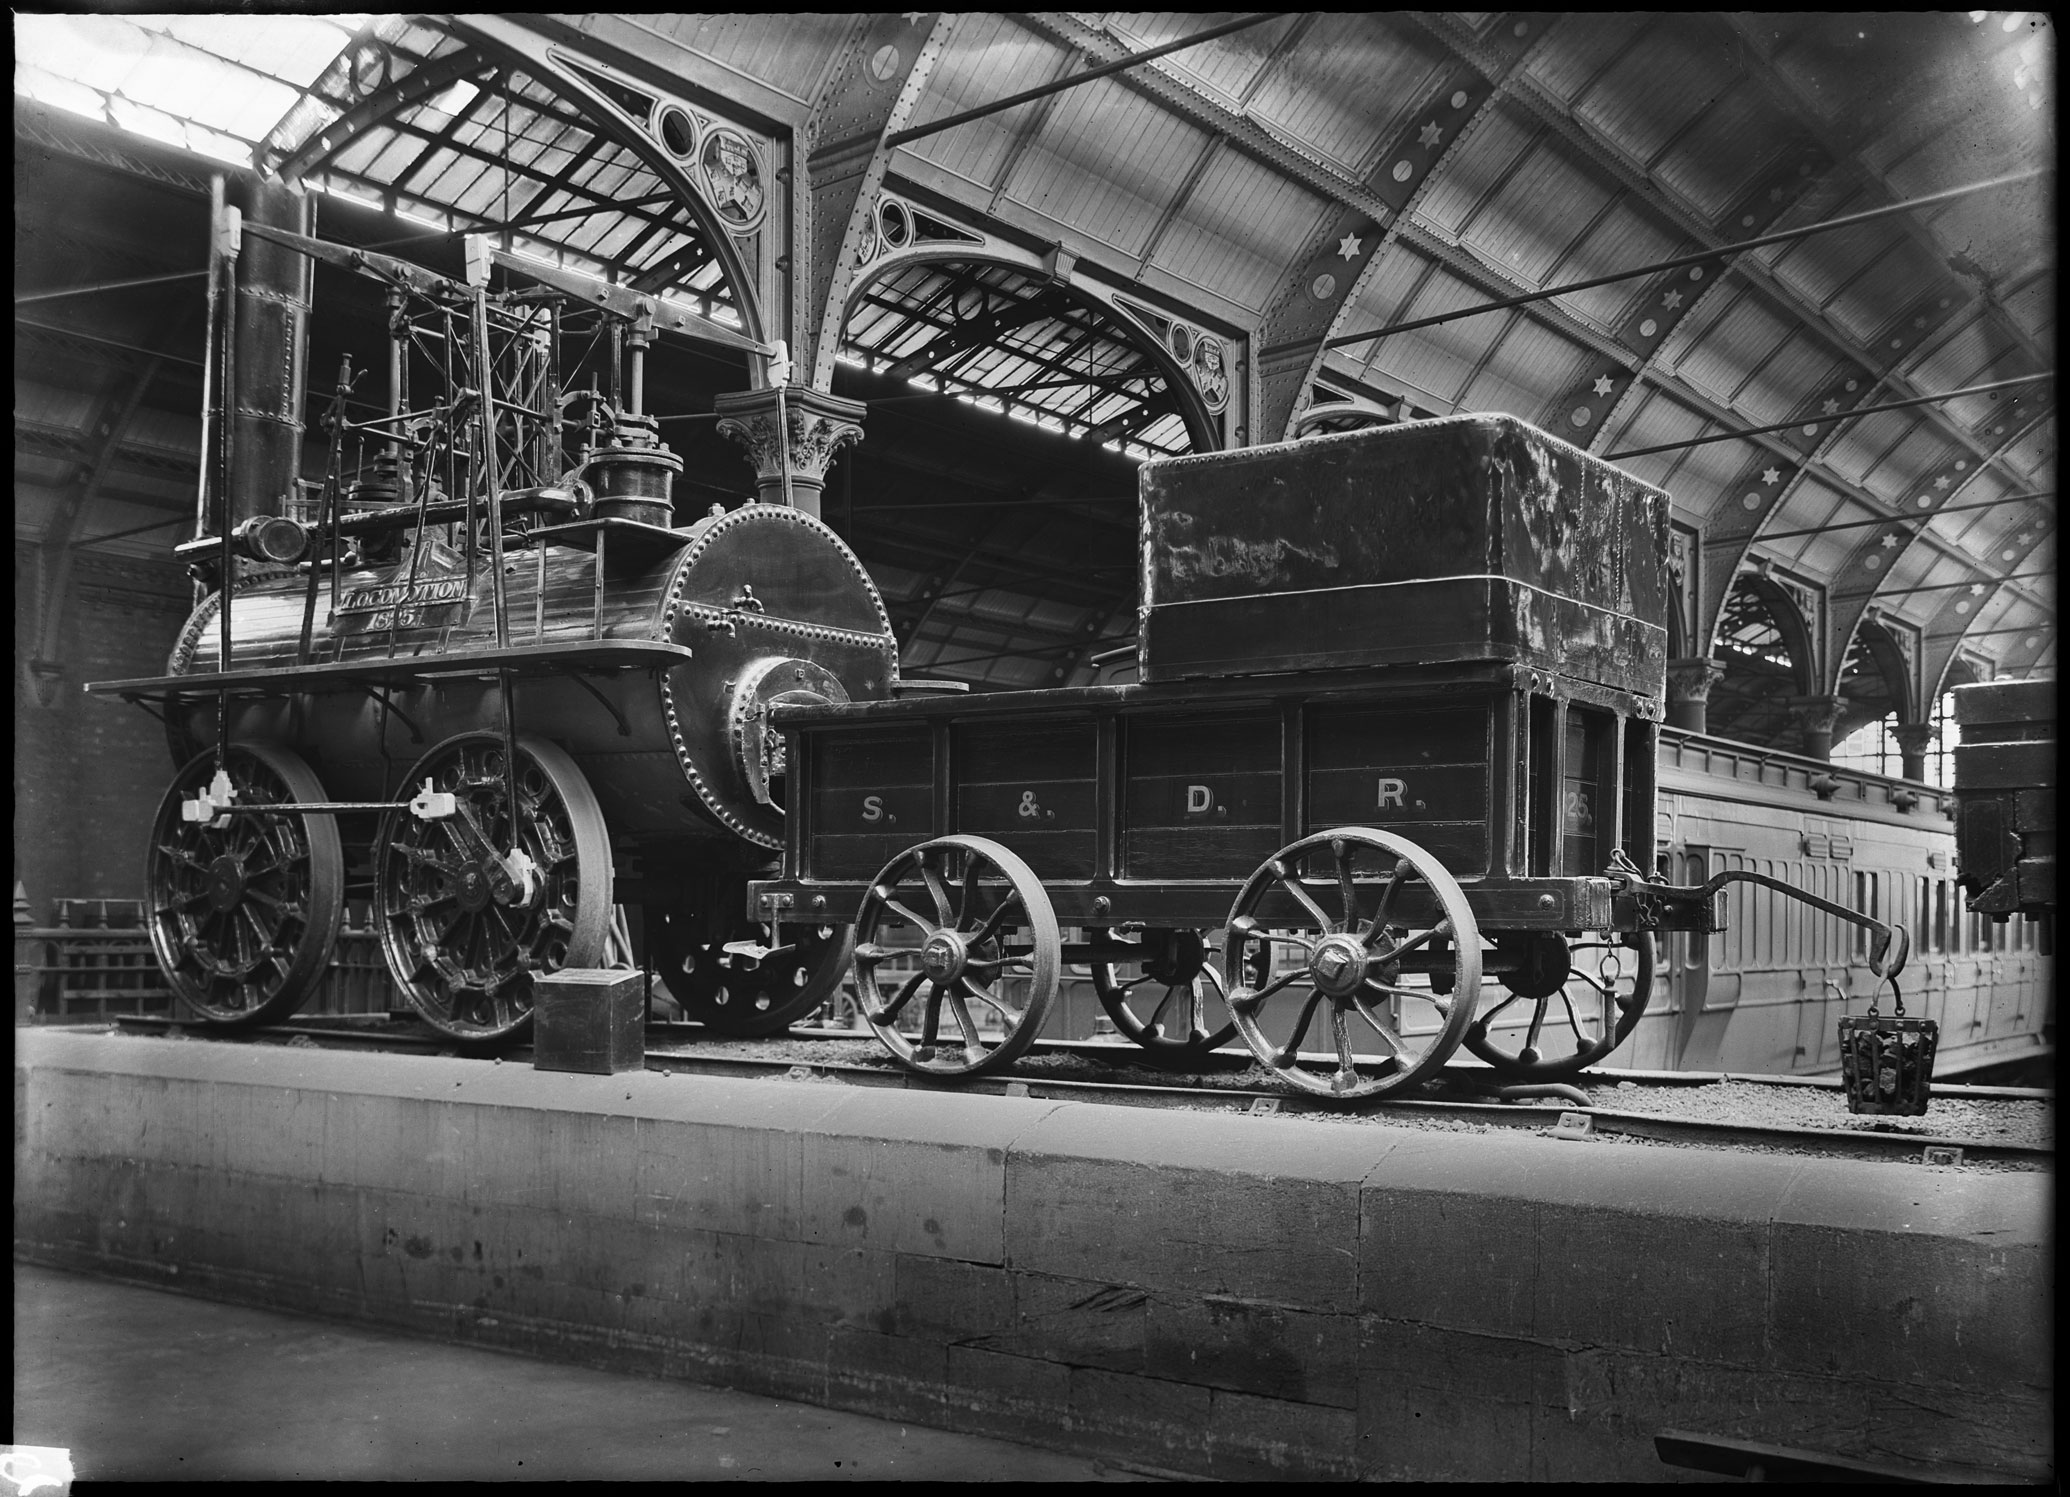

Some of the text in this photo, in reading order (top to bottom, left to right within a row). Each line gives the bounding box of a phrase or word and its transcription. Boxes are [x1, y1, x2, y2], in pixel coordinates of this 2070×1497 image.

[862, 796, 896, 822] S.
[1187, 785, 1226, 817] D.
[1378, 778, 1426, 809] R.
